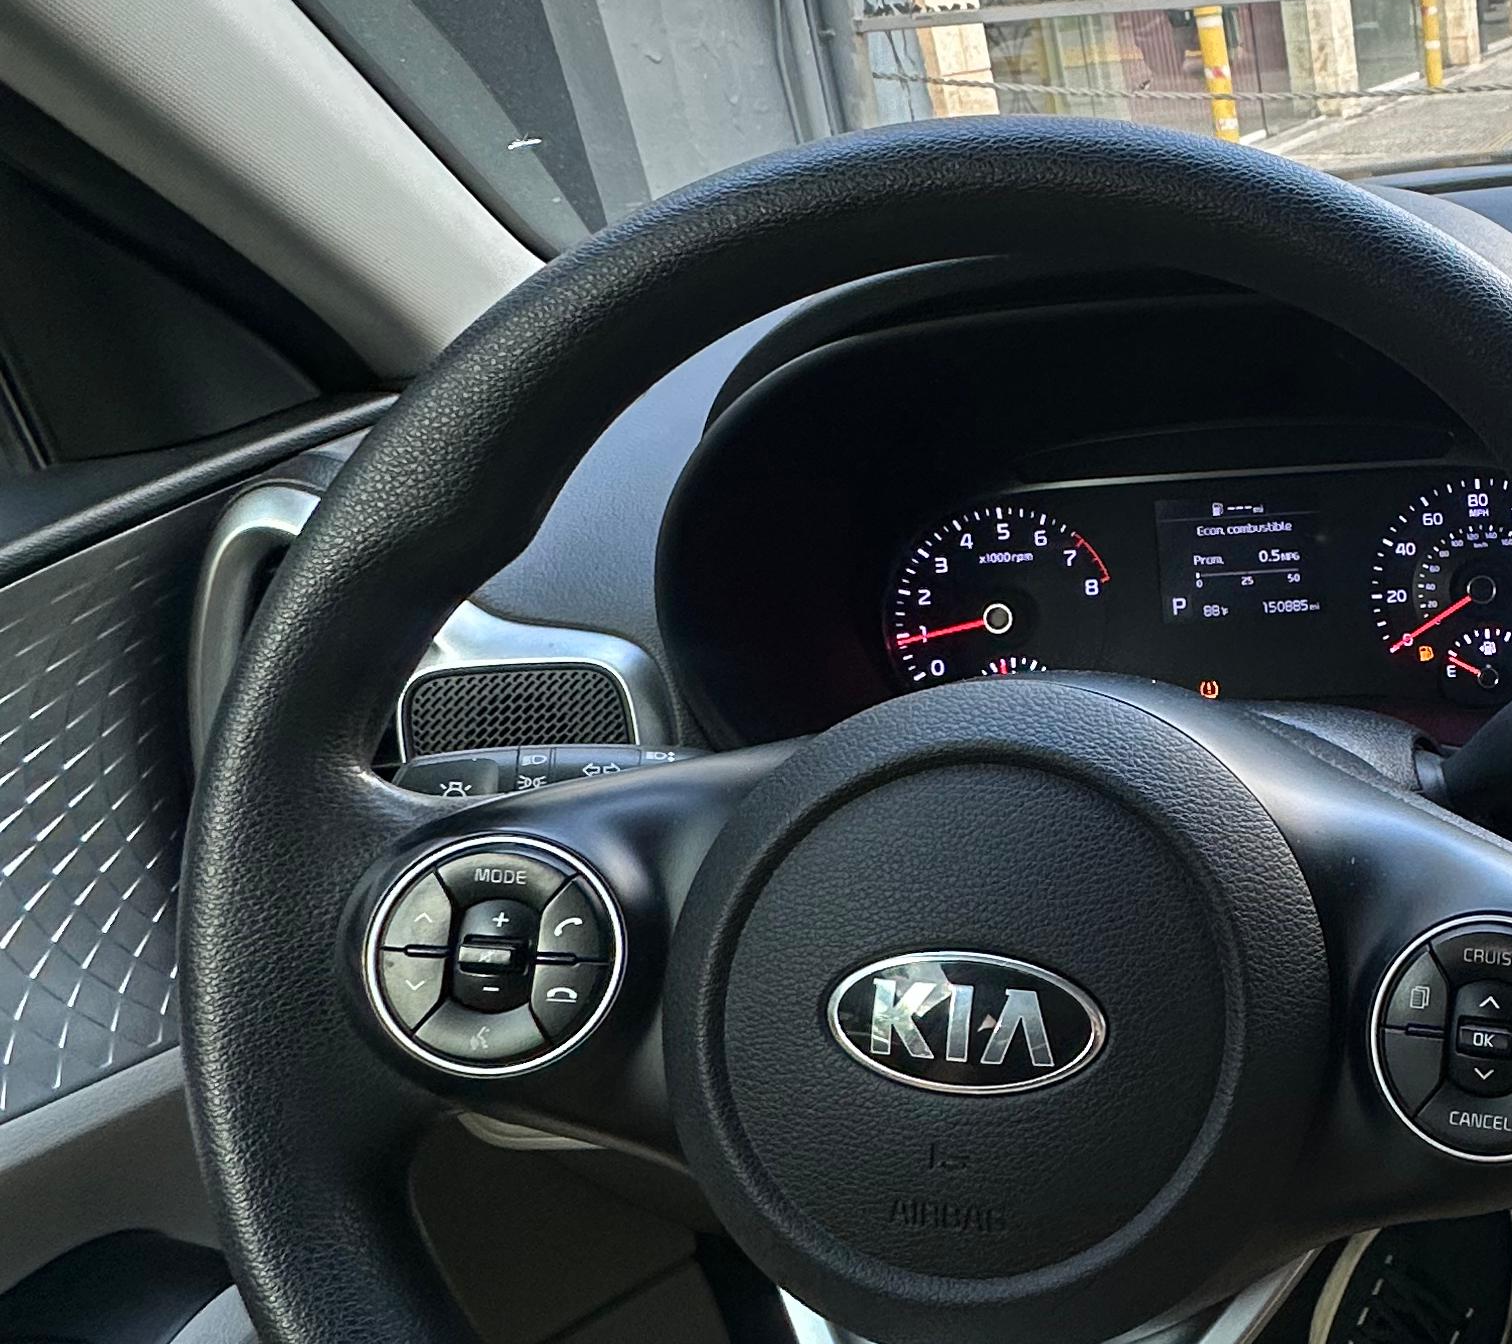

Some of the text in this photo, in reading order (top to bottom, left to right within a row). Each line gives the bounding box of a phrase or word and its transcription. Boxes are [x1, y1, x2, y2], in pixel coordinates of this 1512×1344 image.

[1468, 494, 1489, 507] 80
[1422, 512, 1443, 526] 60
[1469, 508, 1490, 517] MPH
[996, 523, 1010, 540] 5
[1227, 521, 1292, 534] combustible
[960, 533, 973, 549] 4
[1034, 530, 1048, 546] 6
[1395, 542, 1416, 555] 40
[935, 557, 948, 573] 3
[1063, 550, 1077, 566] 7
[1085, 578, 1099, 596] 8
[1241, 576, 1254, 586] 25
[1287, 574, 1301, 583] 50
[918, 589, 931, 605] 2
[1387, 589, 1407, 603] 20
[1172, 597, 1187, 616] P
[930, 659, 945, 676] 0
[1446, 665, 1457, 678] E
[474, 867, 528, 886] MODE
[870, 977, 1055, 1067] KIA
[1473, 1032, 1495, 1048] OK
[1449, 1111, 1512, 1132] CANCEL
